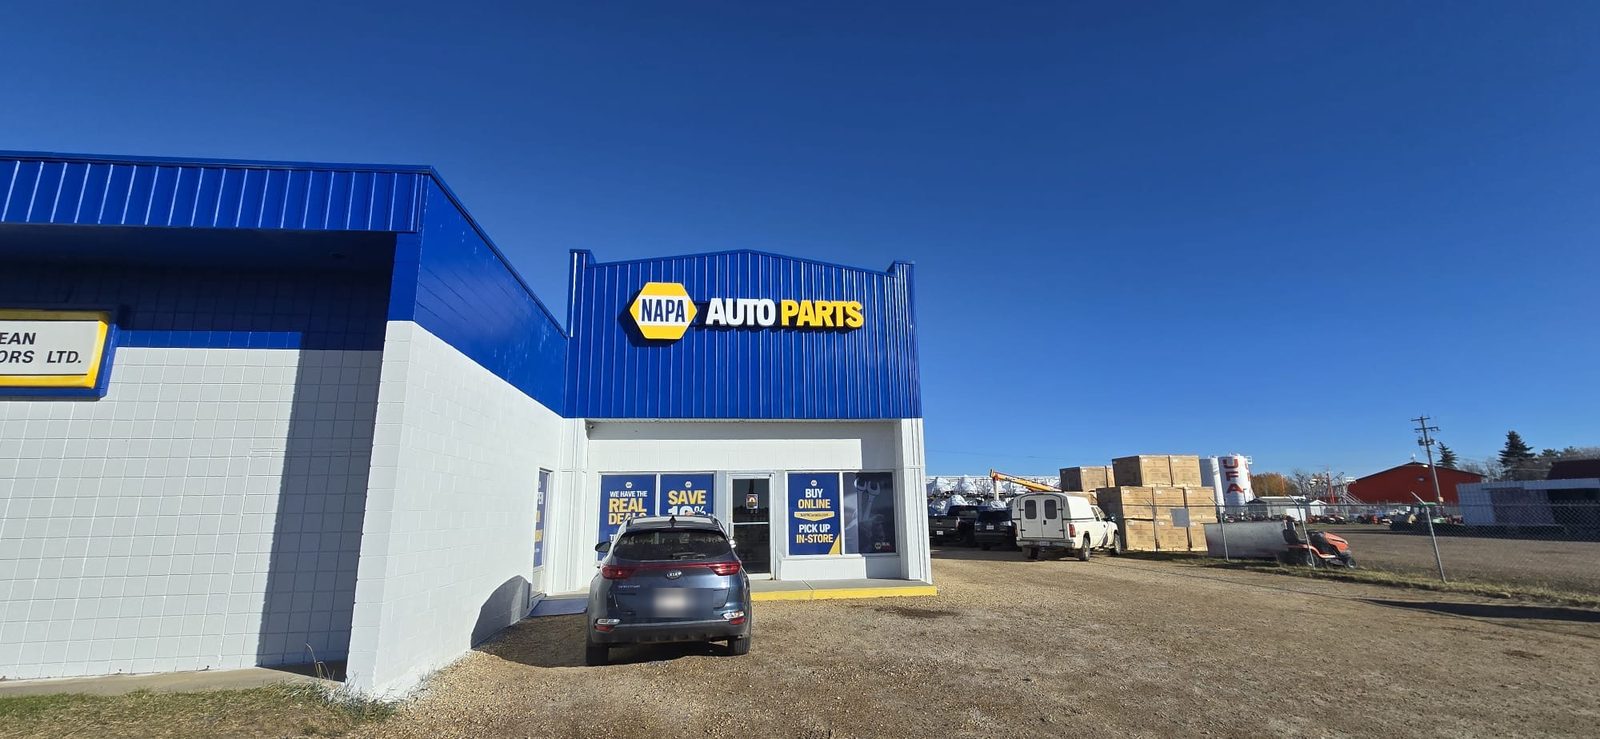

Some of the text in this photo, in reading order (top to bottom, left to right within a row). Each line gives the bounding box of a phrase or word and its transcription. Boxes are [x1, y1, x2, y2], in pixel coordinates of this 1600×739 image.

[641, 297, 865, 329] NAPA AUTO PARTS
[47, 350, 82, 364] LTD.
[1222, 458, 1243, 494] UFA
[609, 490, 619, 498] WE
[620, 490, 636, 498] HAVE
[668, 489, 707, 505] SAVE
[805, 488, 824, 499] BUY
[608, 498, 647, 513] REAL
[798, 499, 831, 509] ONLINE
[798, 523, 831, 534] PICK UP
[796, 534, 834, 544] IN-STORE
